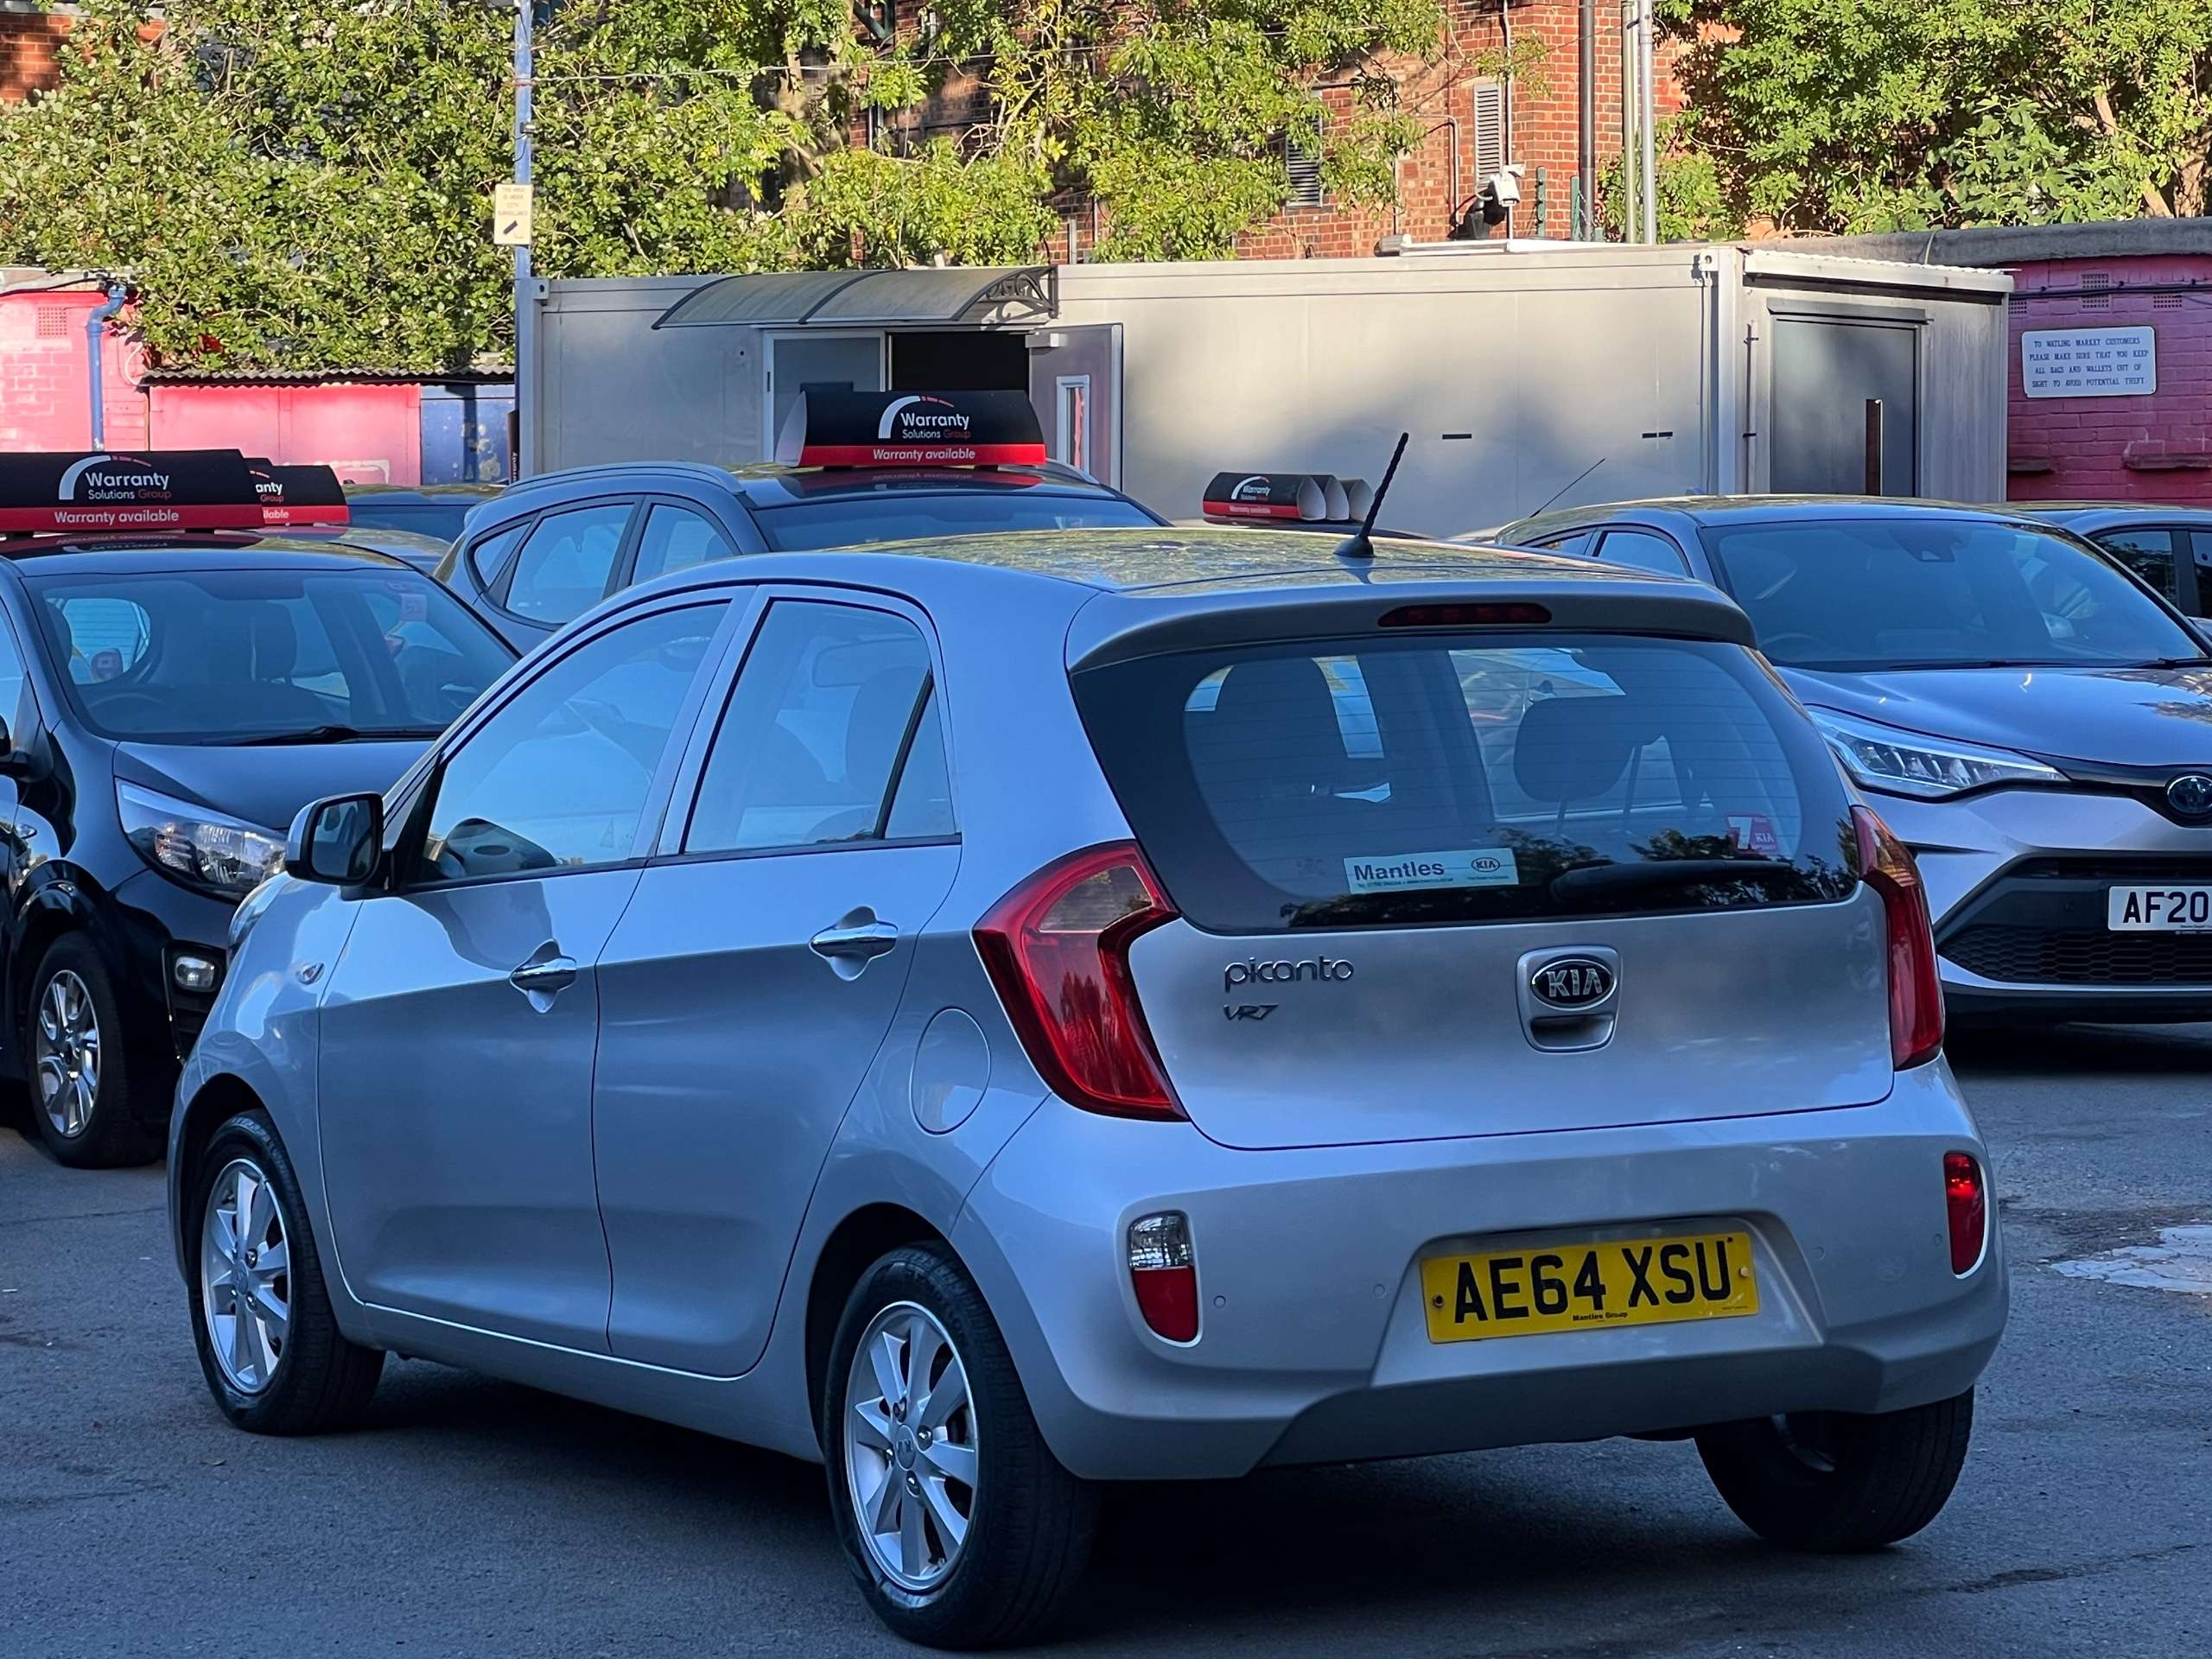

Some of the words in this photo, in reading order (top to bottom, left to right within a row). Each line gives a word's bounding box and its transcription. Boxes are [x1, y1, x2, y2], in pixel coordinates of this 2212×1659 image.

[900, 413, 969, 429] Warranty
[902, 429, 940, 439] Solutions
[944, 429, 970, 439] Group
[873, 448, 923, 461] Warranty
[925, 448, 976, 460] available
[86, 472, 169, 490] Warranty
[256, 481, 283, 495] anty
[88, 489, 135, 499] Solutions
[138, 489, 172, 500] Group
[54, 511, 115, 524] Warranty
[118, 510, 180, 522] available
[1755, 833, 1774, 842] KIA
[1354, 861, 1445, 880] Mantles
[2123, 891, 2209, 924] AF20
[1224, 956, 1355, 993] picanto
[1545, 968, 1603, 998] KIA
[1223, 1003, 1279, 1021] VR7
[1454, 1250, 1606, 1324] AE64
[1621, 1240, 1732, 1307] XSU
